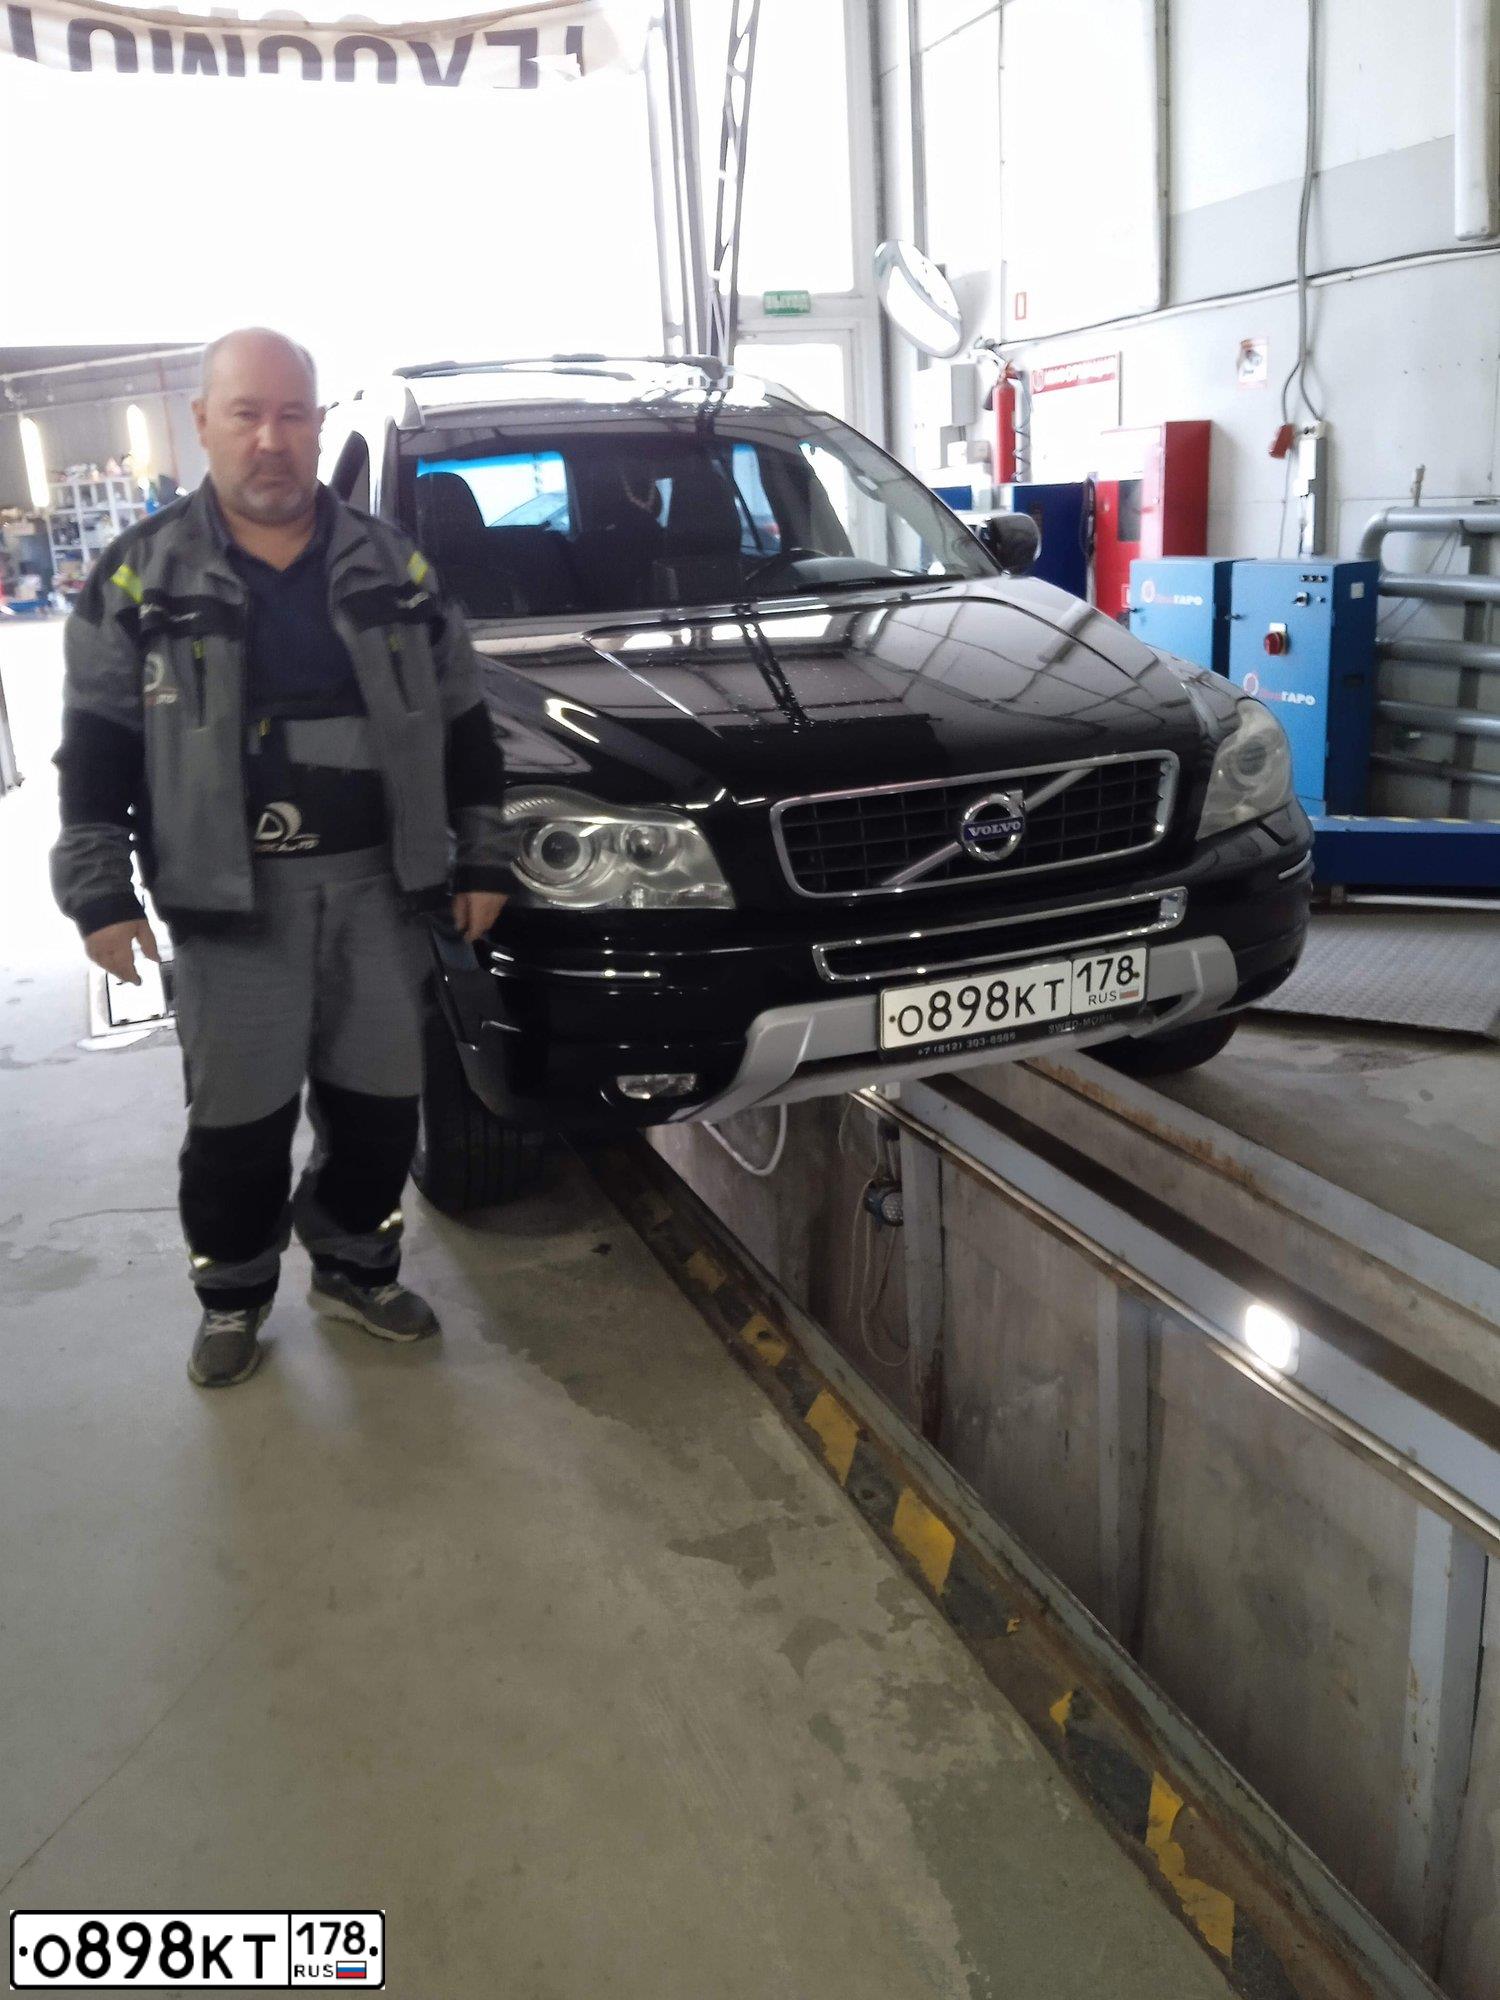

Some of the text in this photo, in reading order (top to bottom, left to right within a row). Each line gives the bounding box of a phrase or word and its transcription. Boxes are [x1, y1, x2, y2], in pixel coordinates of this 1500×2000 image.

[968, 821, 1022, 837] VOLVO
[1076, 955, 1135, 993] 178
[897, 979, 1065, 1037] O898KT
[1088, 990, 1117, 1006] RUS
